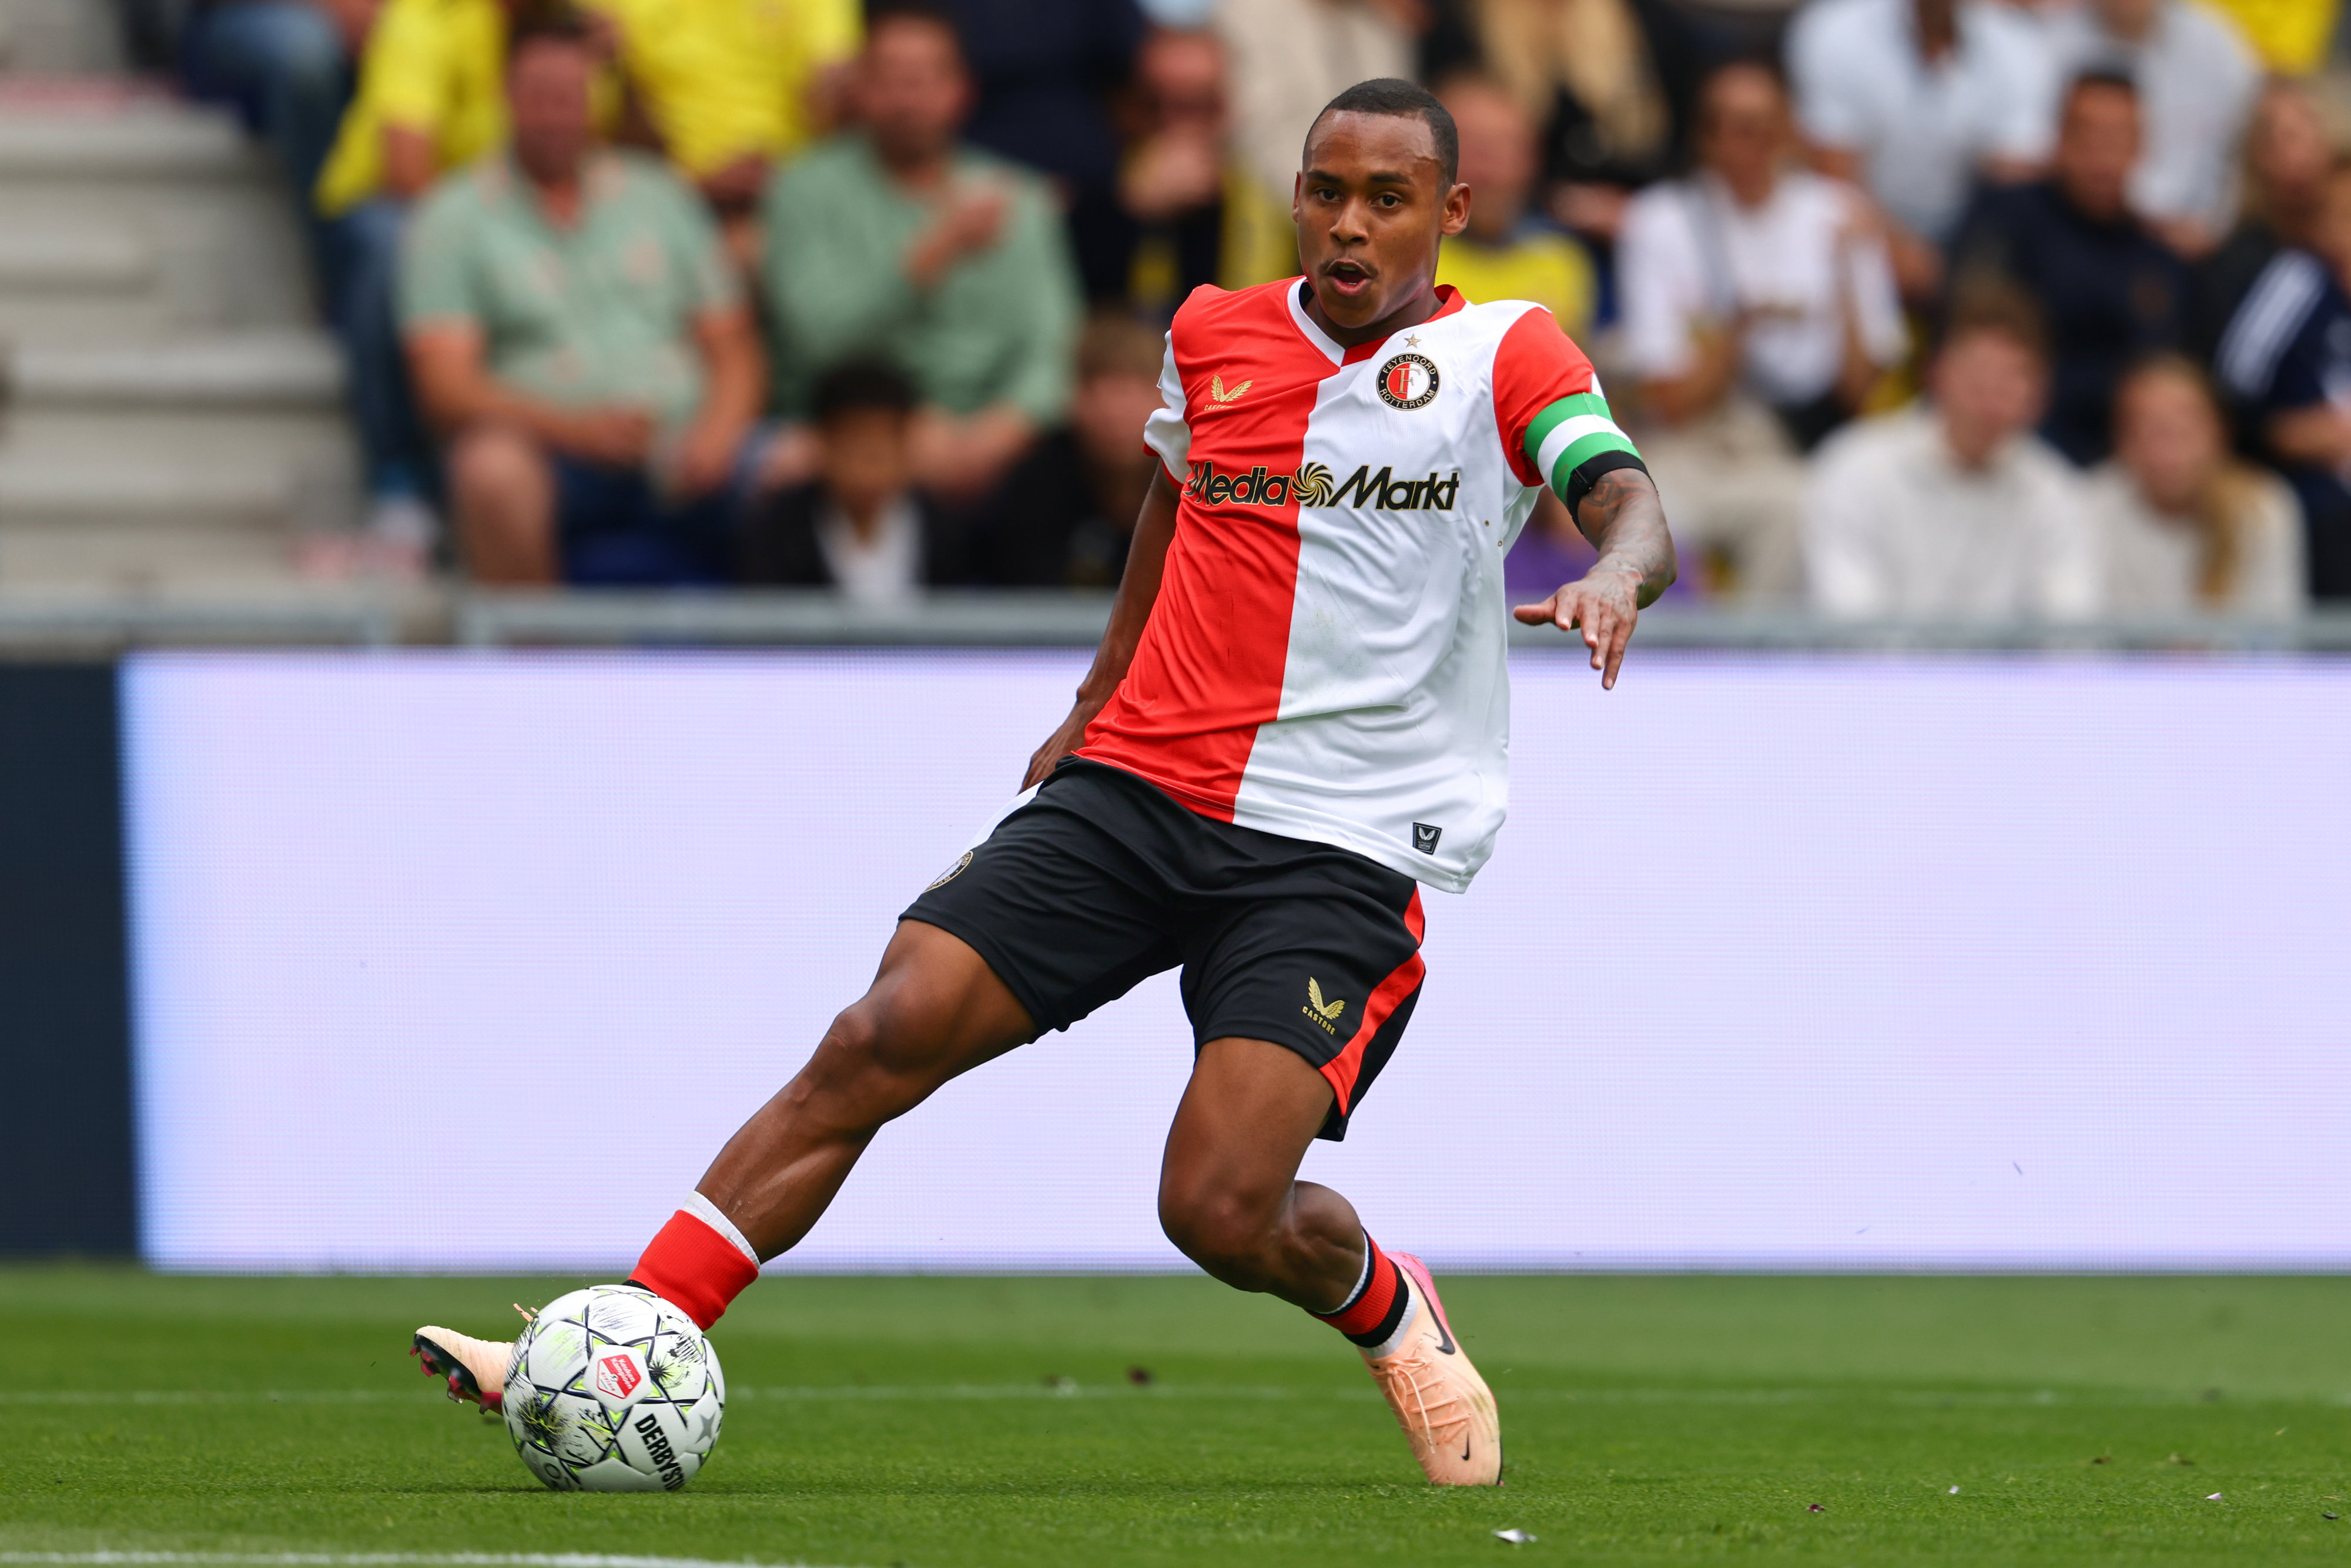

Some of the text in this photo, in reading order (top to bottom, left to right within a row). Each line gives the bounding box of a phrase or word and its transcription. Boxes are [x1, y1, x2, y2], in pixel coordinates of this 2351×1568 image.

[1382, 354, 1436, 375] FEYENOORD
[1395, 367, 1421, 394] F
[1379, 388, 1436, 409] ROTTERDAM
[1182, 461, 1459, 510] Media Markt
[1302, 1006, 1335, 1035] CASTORE
[634, 1413, 685, 1492] DERBYST
